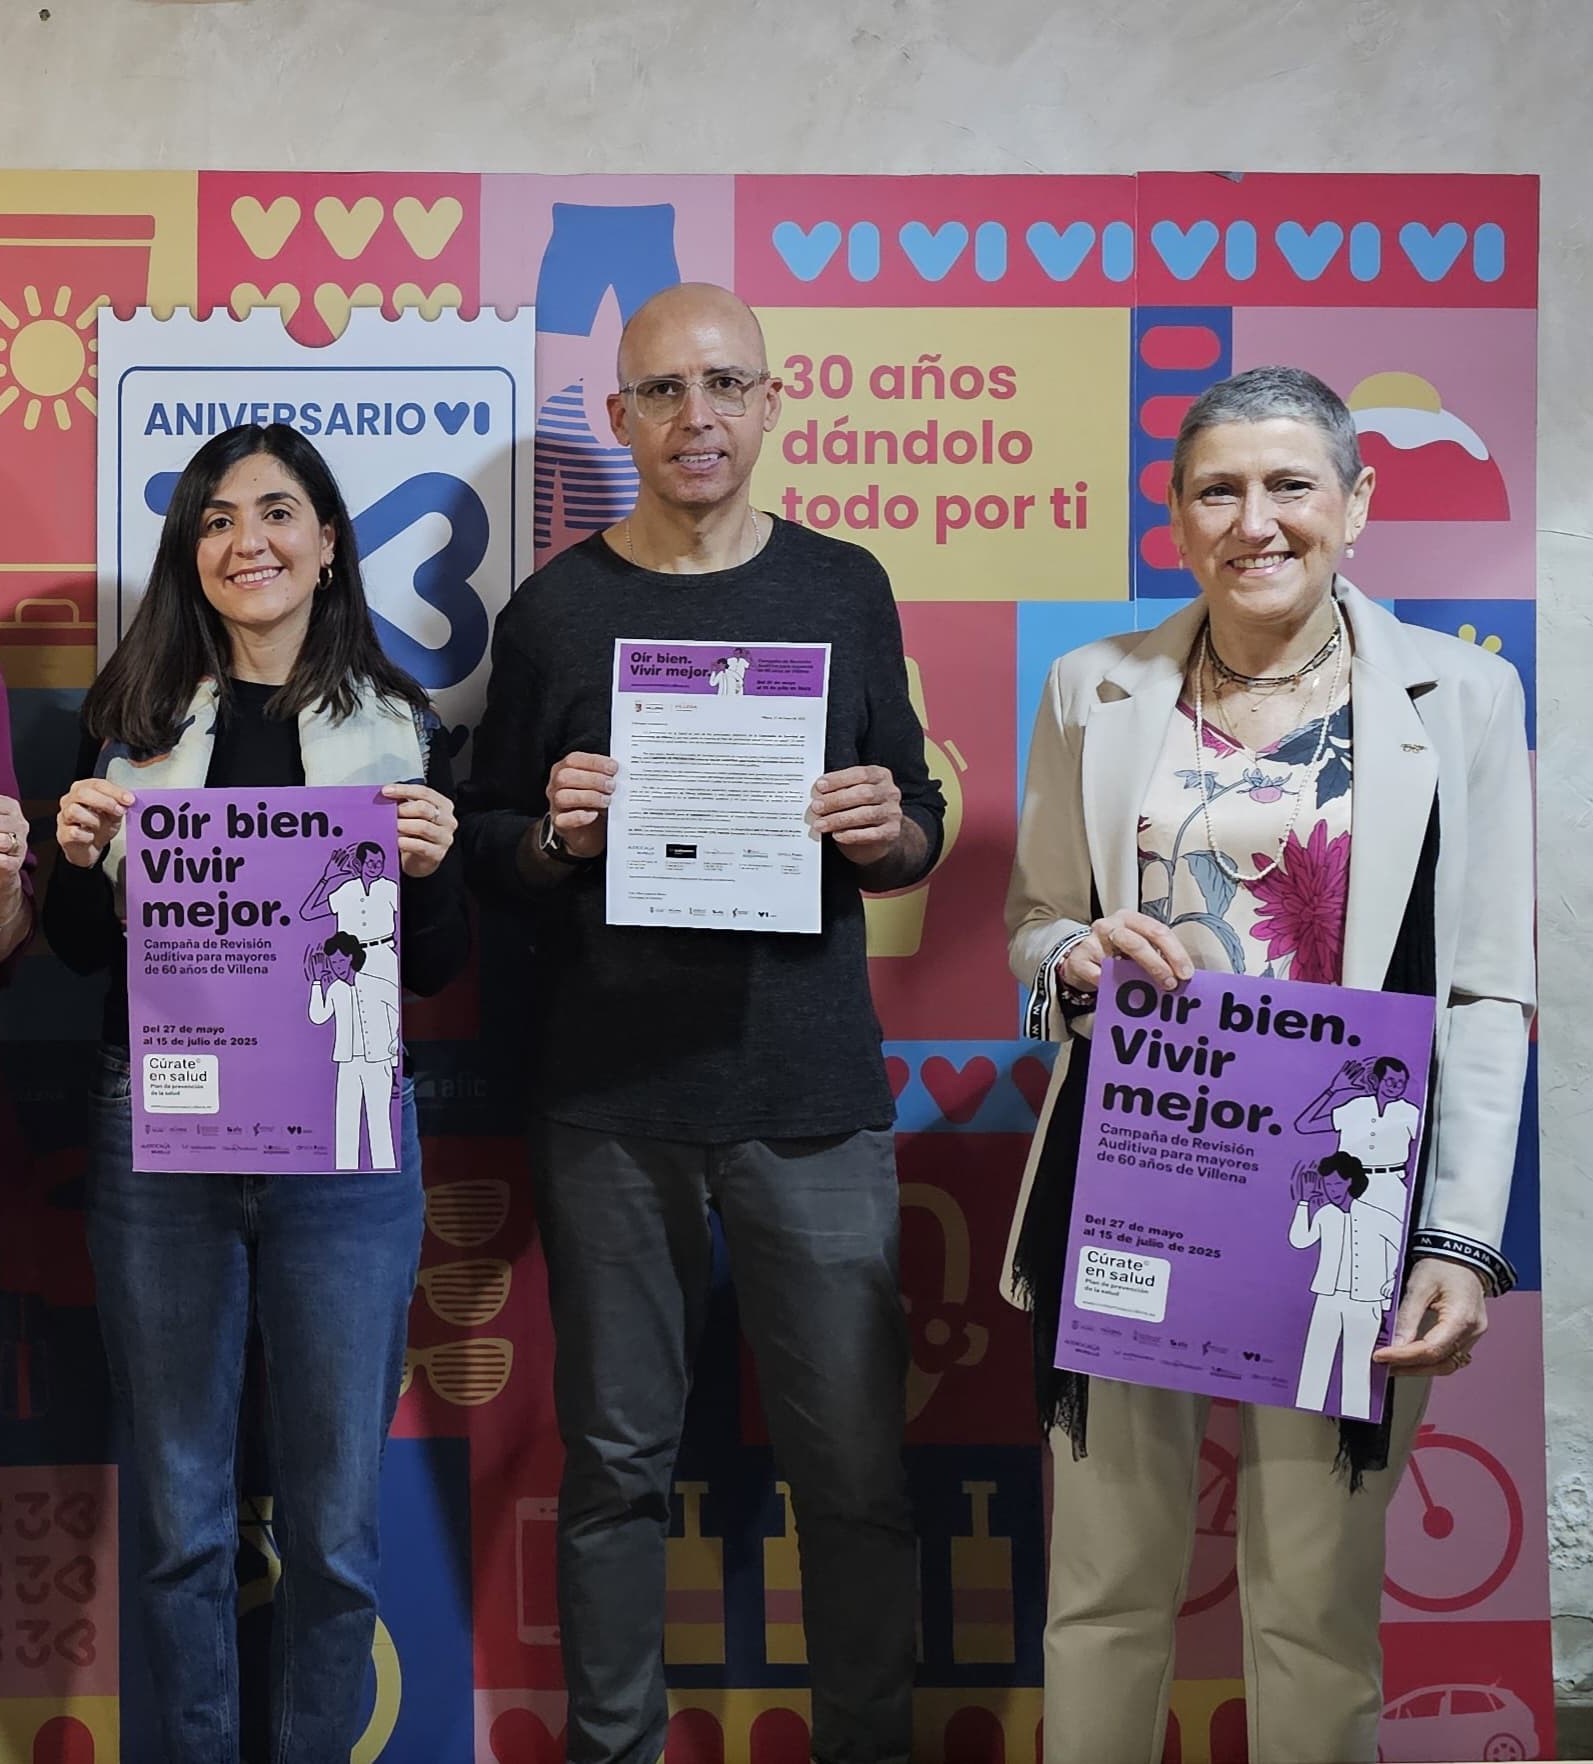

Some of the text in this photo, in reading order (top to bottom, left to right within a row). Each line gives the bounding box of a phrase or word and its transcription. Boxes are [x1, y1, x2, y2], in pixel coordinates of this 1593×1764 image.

[782, 353, 1017, 400] 30 años
[782, 415, 1033, 465] dándolo
[781, 481, 1089, 545] todo por ti
[630, 664, 711, 679] Vivir mejor.
[631, 652, 692, 664] Oír bien.
[141, 802, 343, 840] Oír bien.
[141, 846, 245, 884] Vivir
[143, 890, 291, 936] mejor.
[144, 938, 272, 951] Campaña de Revisión
[144, 951, 277, 964] Auditiva para mayores
[145, 964, 268, 975] de 60 años de Villena
[143, 1025, 225, 1035] Del 27 de mayo
[1219, 992, 1361, 1047] bien.
[143, 1037, 258, 1047] al 15 de julio de 2025
[1111, 1025, 1236, 1078] Vivir
[149, 1070, 207, 1082] en salud
[1100, 1083, 1282, 1137] mejor.
[1098, 1123, 1254, 1157] Campaña de Revisión
[1098, 1137, 1259, 1172] Auditiva para mayores
[1097, 1150, 1250, 1184] de 60 años de Villena
[1083, 1228, 1221, 1258] al 15 de julio de 2025
[1085, 1214, 1184, 1239] Del 27 de mayo
[1085, 1266, 1155, 1287] en salud
